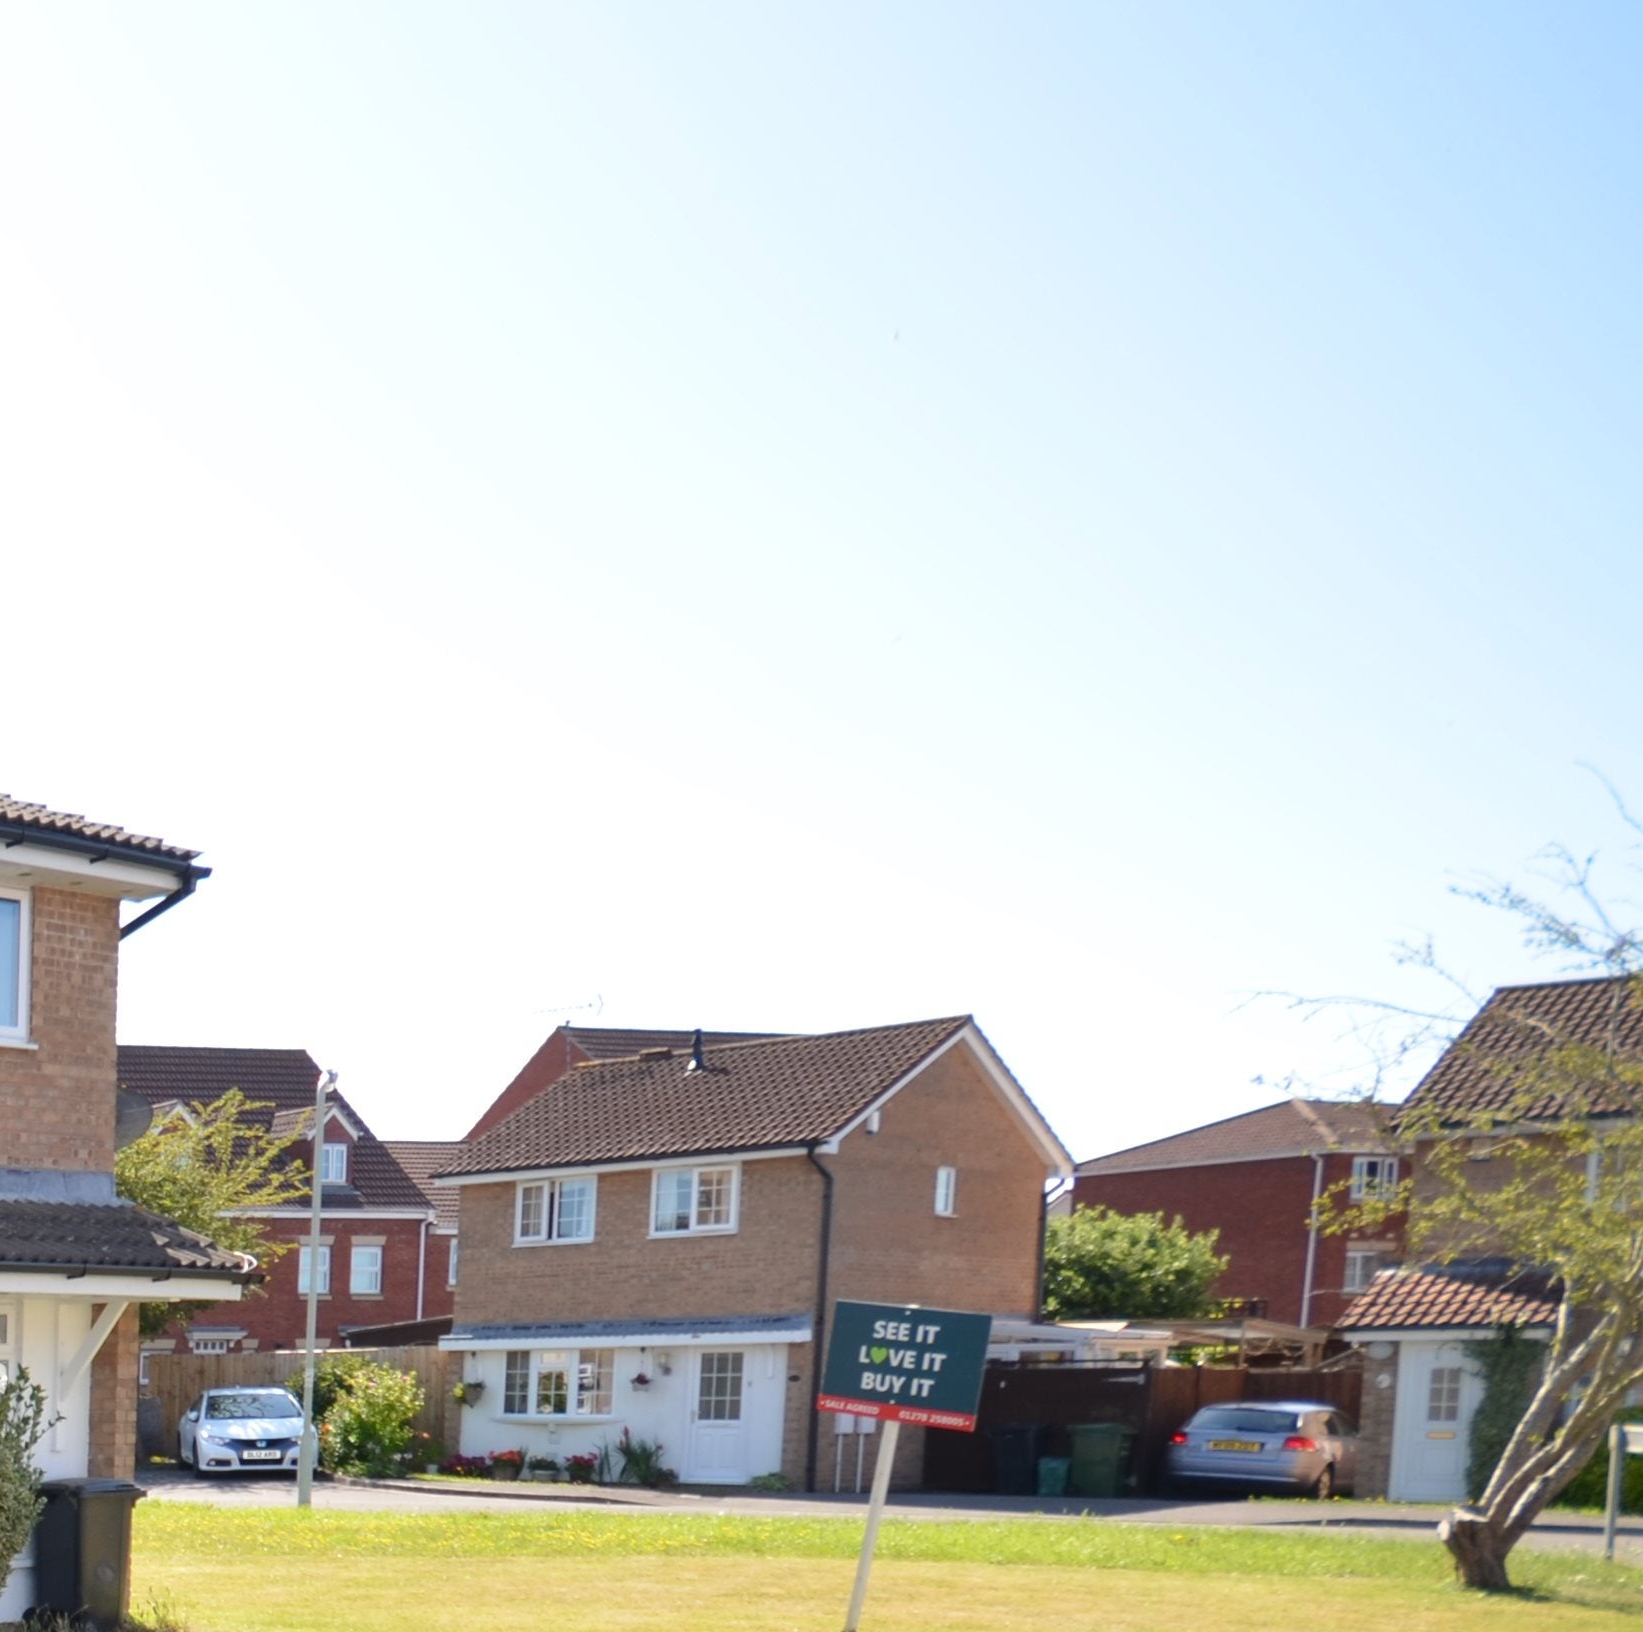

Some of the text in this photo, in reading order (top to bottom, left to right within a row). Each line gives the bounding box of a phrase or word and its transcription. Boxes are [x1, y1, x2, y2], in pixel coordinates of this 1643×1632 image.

[873, 1320, 941, 1344] SEE IT
[922, 1352, 947, 1372] IT
[860, 1371, 935, 1398] BUY IT
